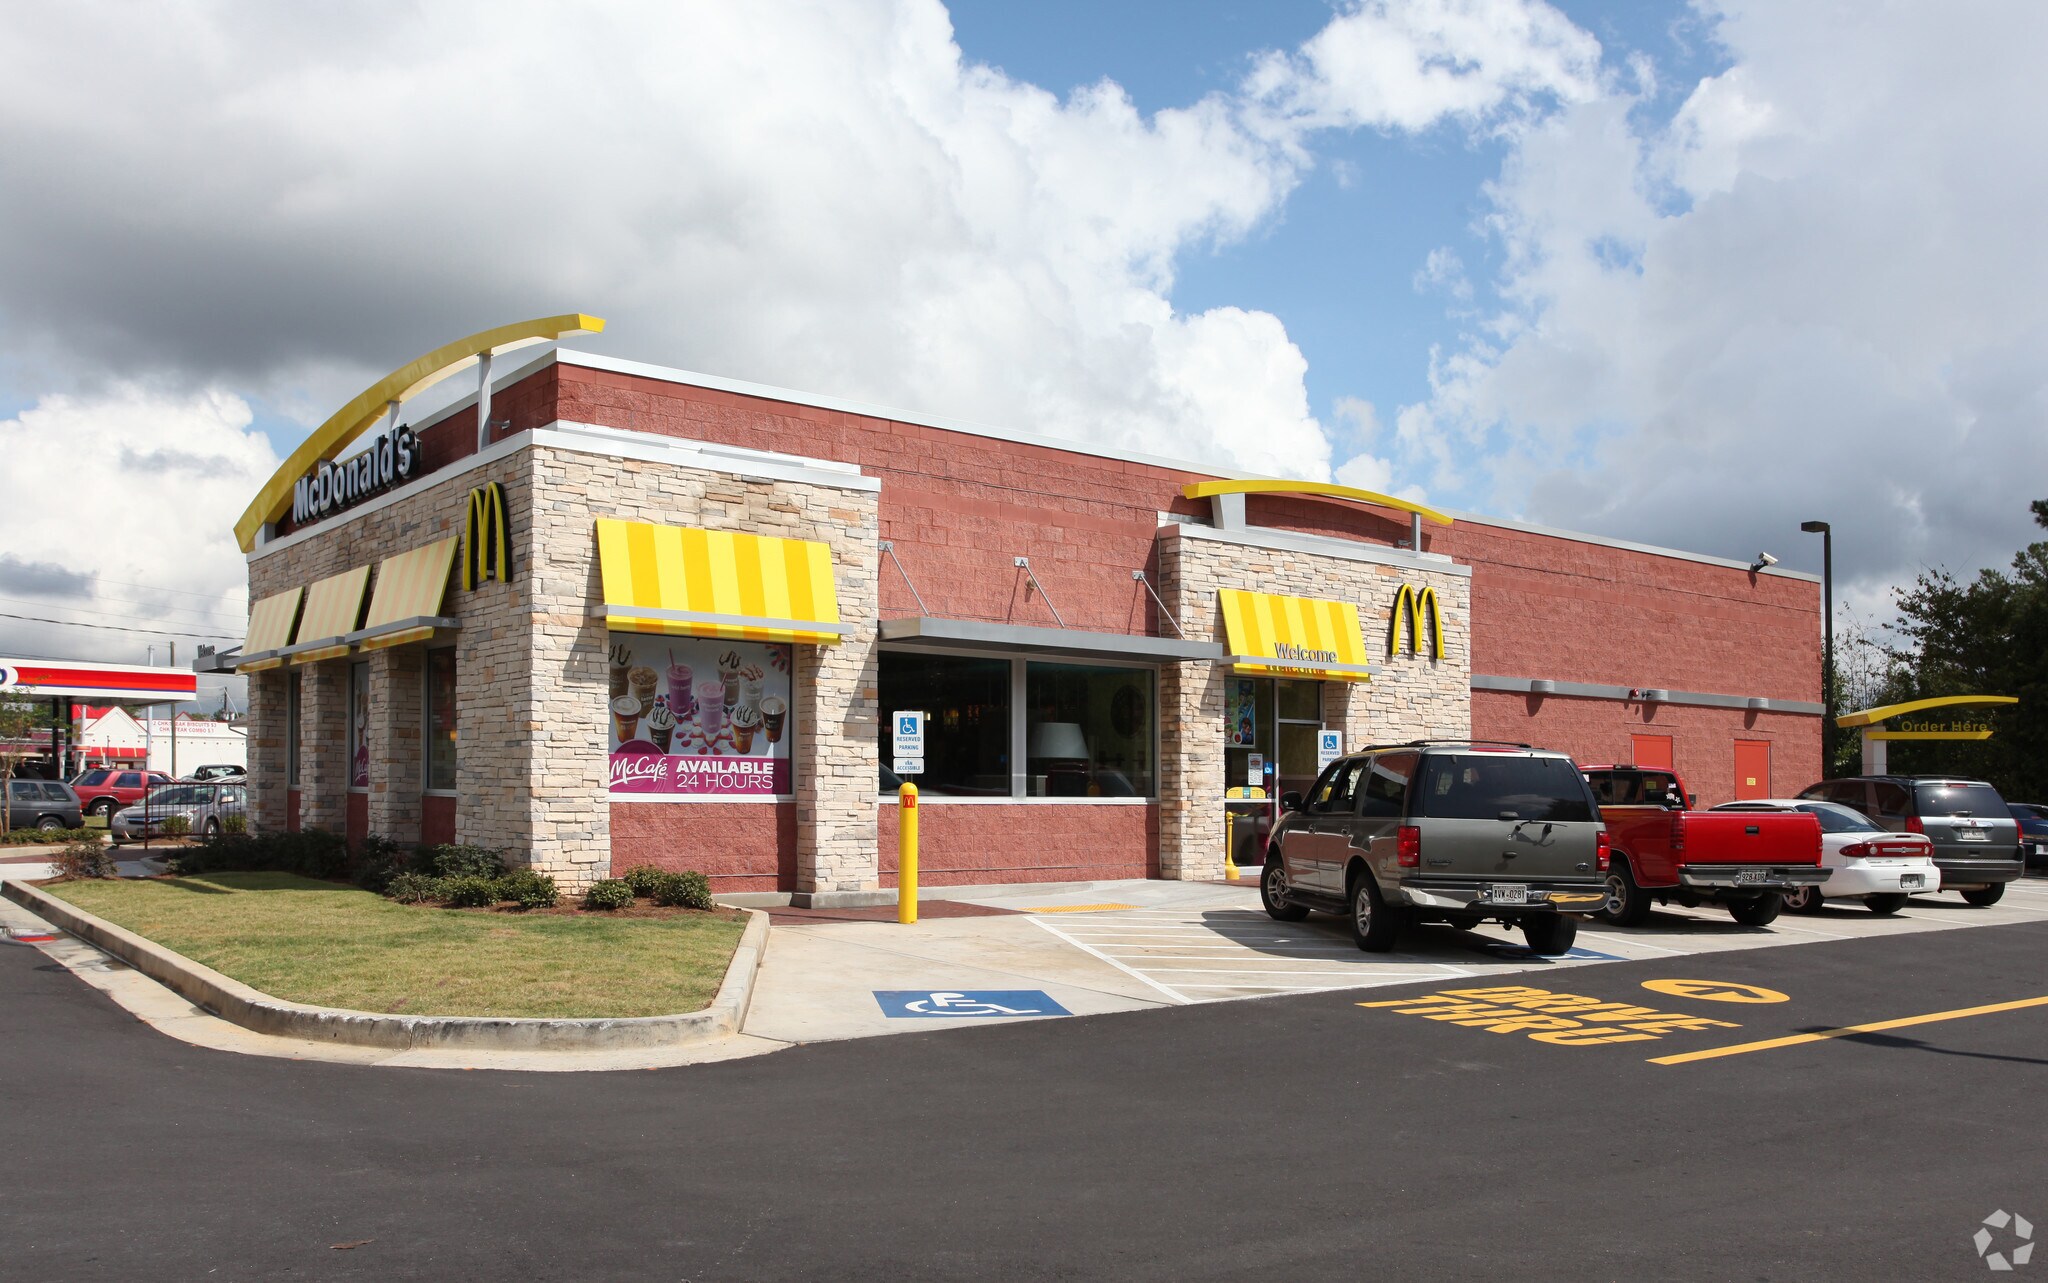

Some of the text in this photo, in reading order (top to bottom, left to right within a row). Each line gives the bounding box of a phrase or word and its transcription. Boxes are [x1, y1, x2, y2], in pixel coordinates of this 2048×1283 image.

[293, 424, 412, 523] McDonald's
[1274, 642, 1338, 664] Welcome
[1901, 720, 1988, 732] Order Here
[676, 760, 774, 775] AVAILABLE
[676, 774, 774, 789] 24 HOURS
[1354, 995, 1663, 1046] THRU
[1435, 986, 1743, 1034] DRIVE
